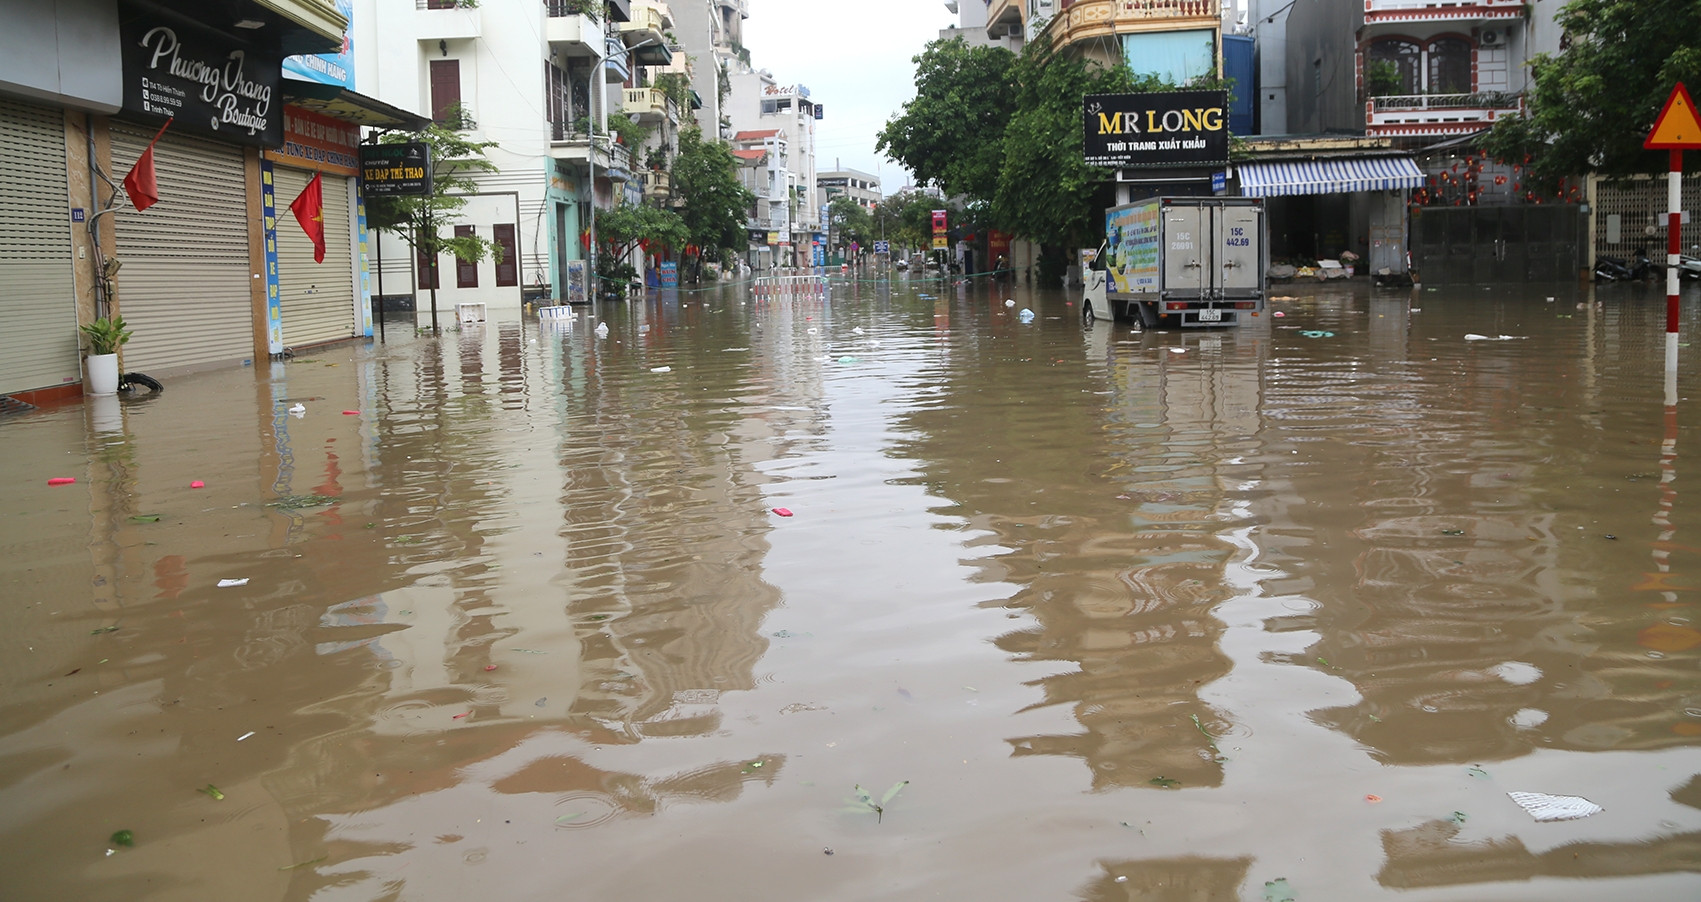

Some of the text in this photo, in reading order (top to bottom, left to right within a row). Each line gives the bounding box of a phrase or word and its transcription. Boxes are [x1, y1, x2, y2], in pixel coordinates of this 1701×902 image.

[141, 26, 220, 102] Phương
[327, 61, 347, 82] HÀNG
[216, 93, 267, 135] Boutique
[1098, 107, 1223, 135] MR LONG
[304, 144, 313, 160] XE
[1107, 139, 1127, 152] THỜI
[1128, 141, 1157, 151] TRANG
[1158, 137, 1181, 150] XUẤT
[364, 161, 424, 183] XE ĐẠP THỂ THAO
[74, 211, 84, 220] 112
[1176, 232, 1191, 240] 15C
[1230, 227, 1244, 236] 15C
[1226, 238, 1250, 246] 442.69
